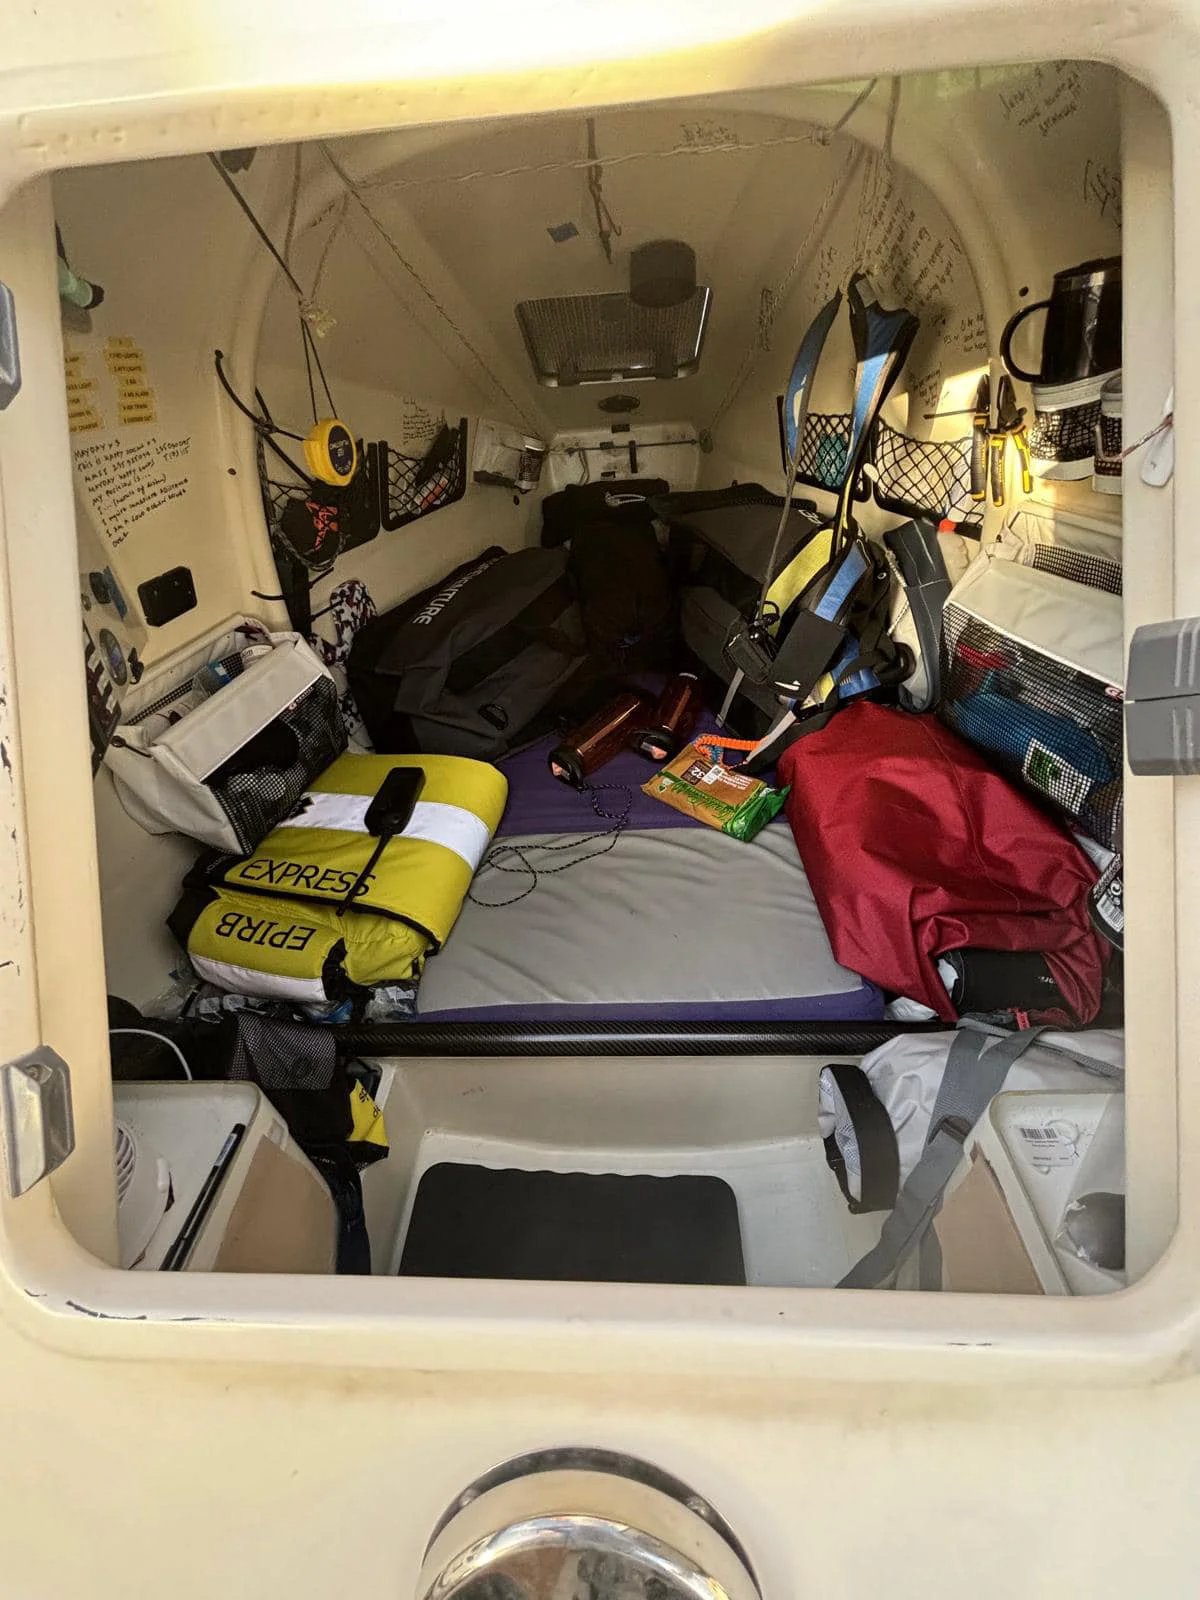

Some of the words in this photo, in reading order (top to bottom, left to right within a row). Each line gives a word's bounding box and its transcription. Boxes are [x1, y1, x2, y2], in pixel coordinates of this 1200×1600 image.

[691, 766, 706, 779] 32
[239, 859, 376, 897] EXPRESS
[215, 912, 317, 951] EPIRB
